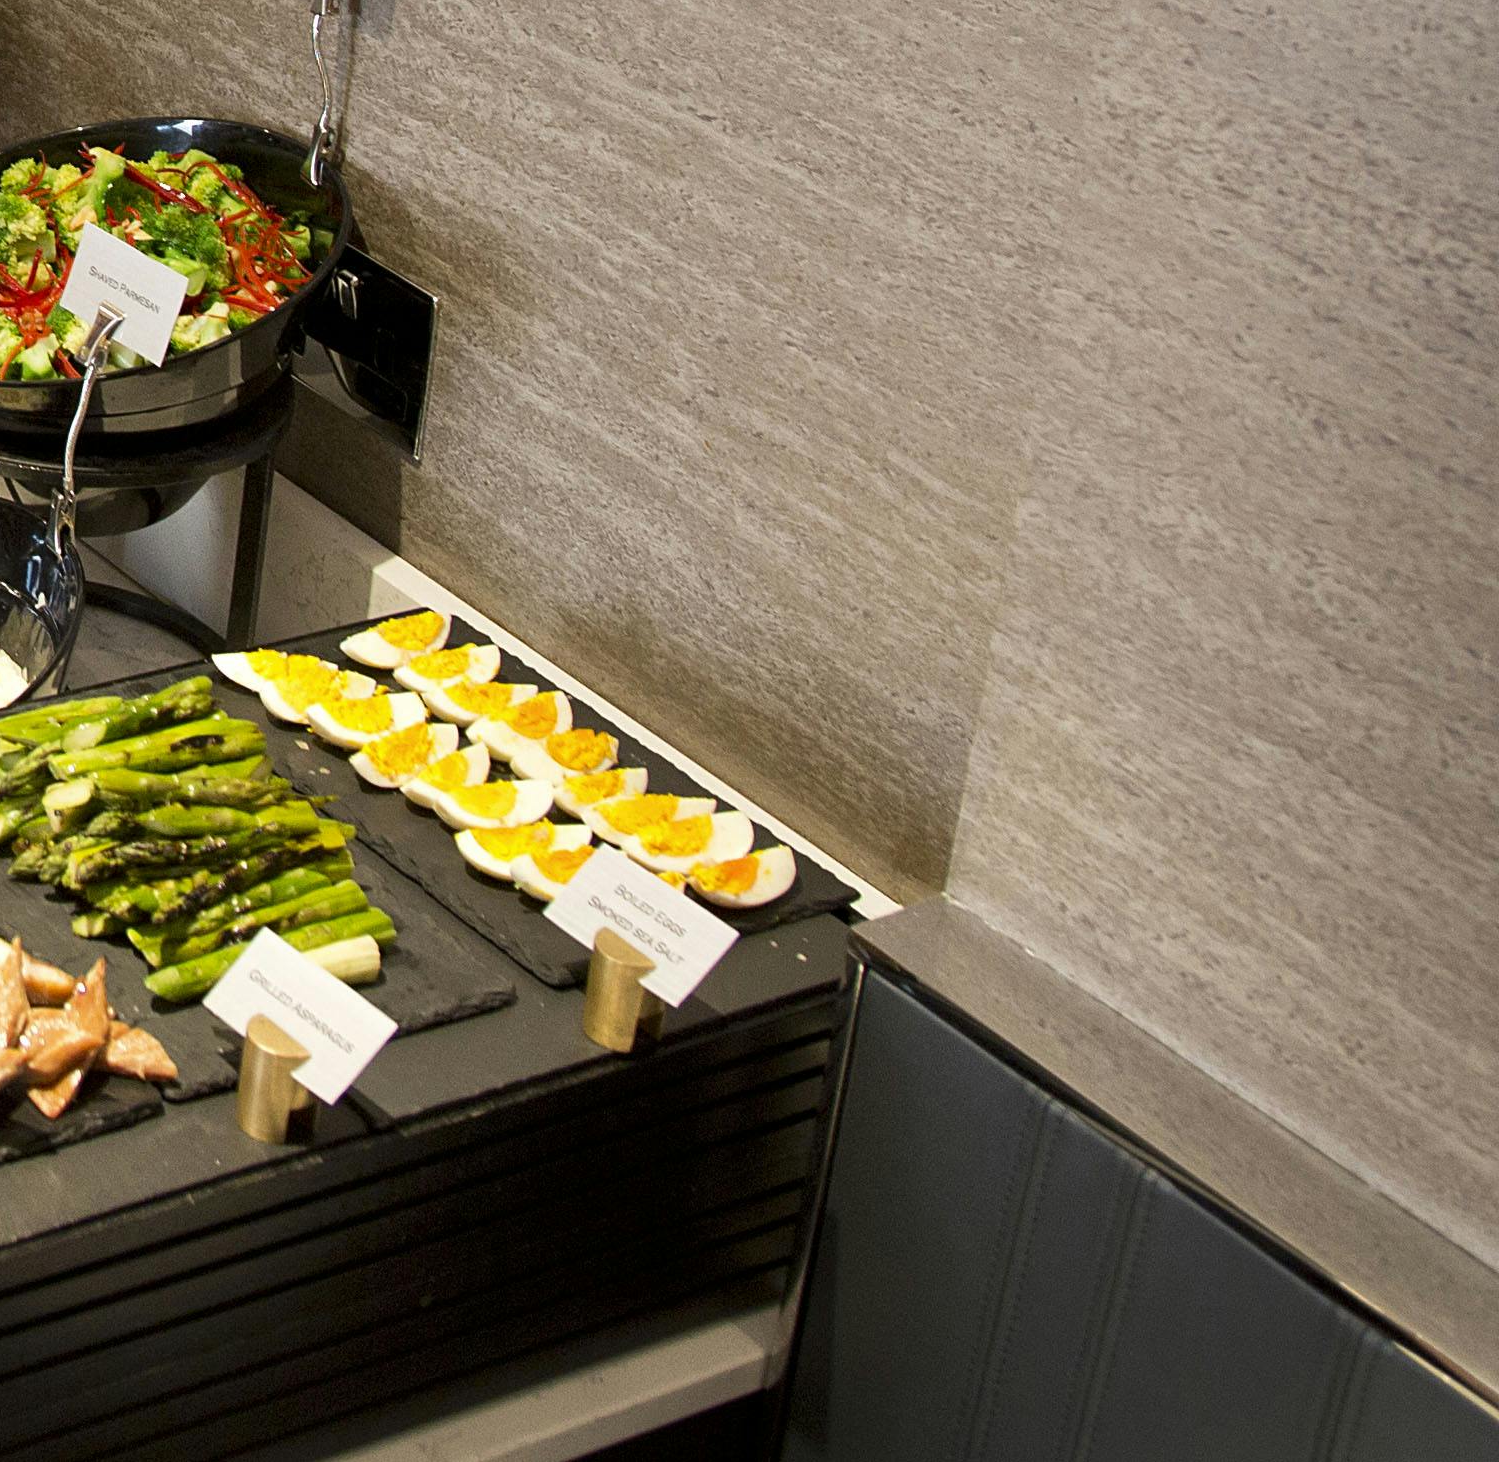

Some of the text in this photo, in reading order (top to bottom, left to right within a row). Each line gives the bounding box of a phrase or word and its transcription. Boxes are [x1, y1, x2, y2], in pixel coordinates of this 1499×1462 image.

[88, 265, 161, 314] SHAVED PARMESAN
[587, 895, 633, 931] SMOKED
[654, 941, 685, 965] SALT
[614, 883, 687, 938] BOILED EGGS
[249, 969, 355, 1055] GRILLED ASPARAGUS
